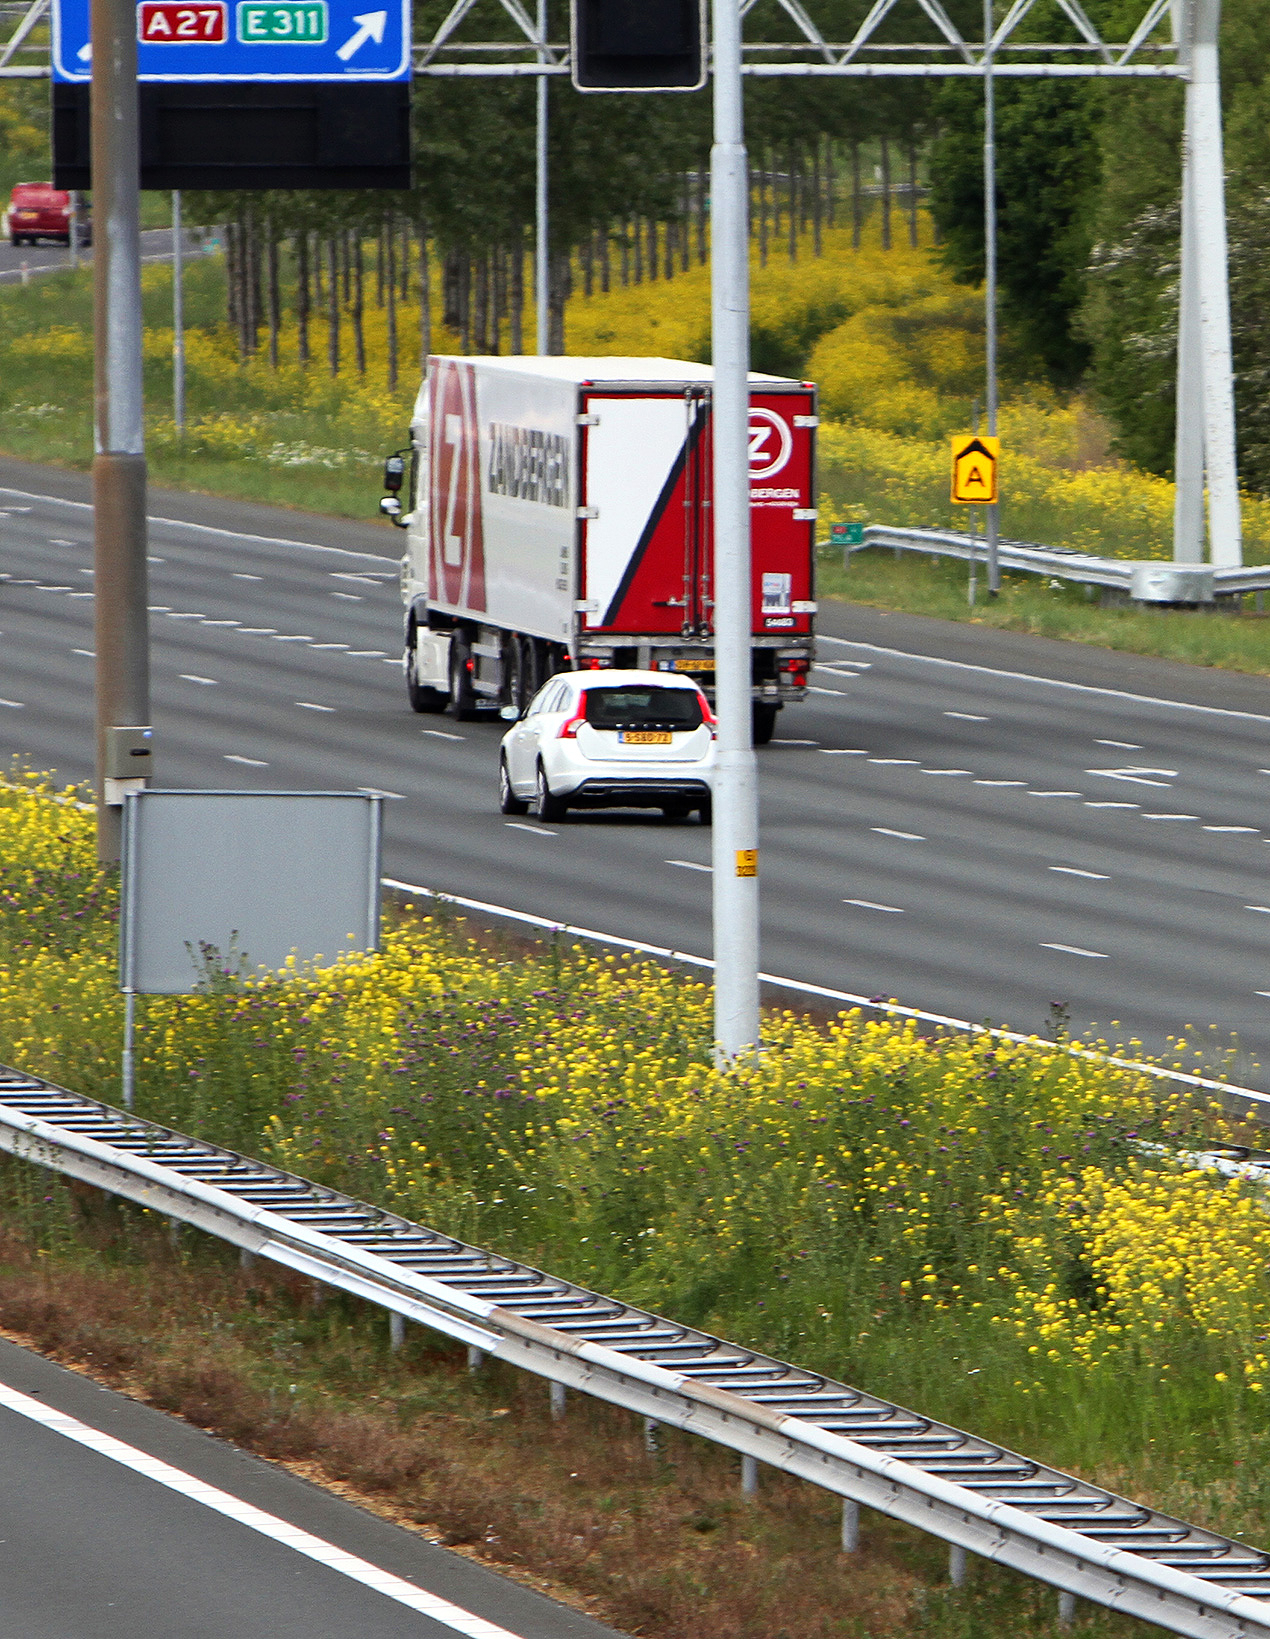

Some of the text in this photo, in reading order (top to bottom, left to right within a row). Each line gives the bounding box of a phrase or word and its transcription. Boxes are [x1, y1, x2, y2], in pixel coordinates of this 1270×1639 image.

[147, 10, 220, 35] A27
[965, 467, 985, 487] A
[749, 488, 800, 499] BERGEN
